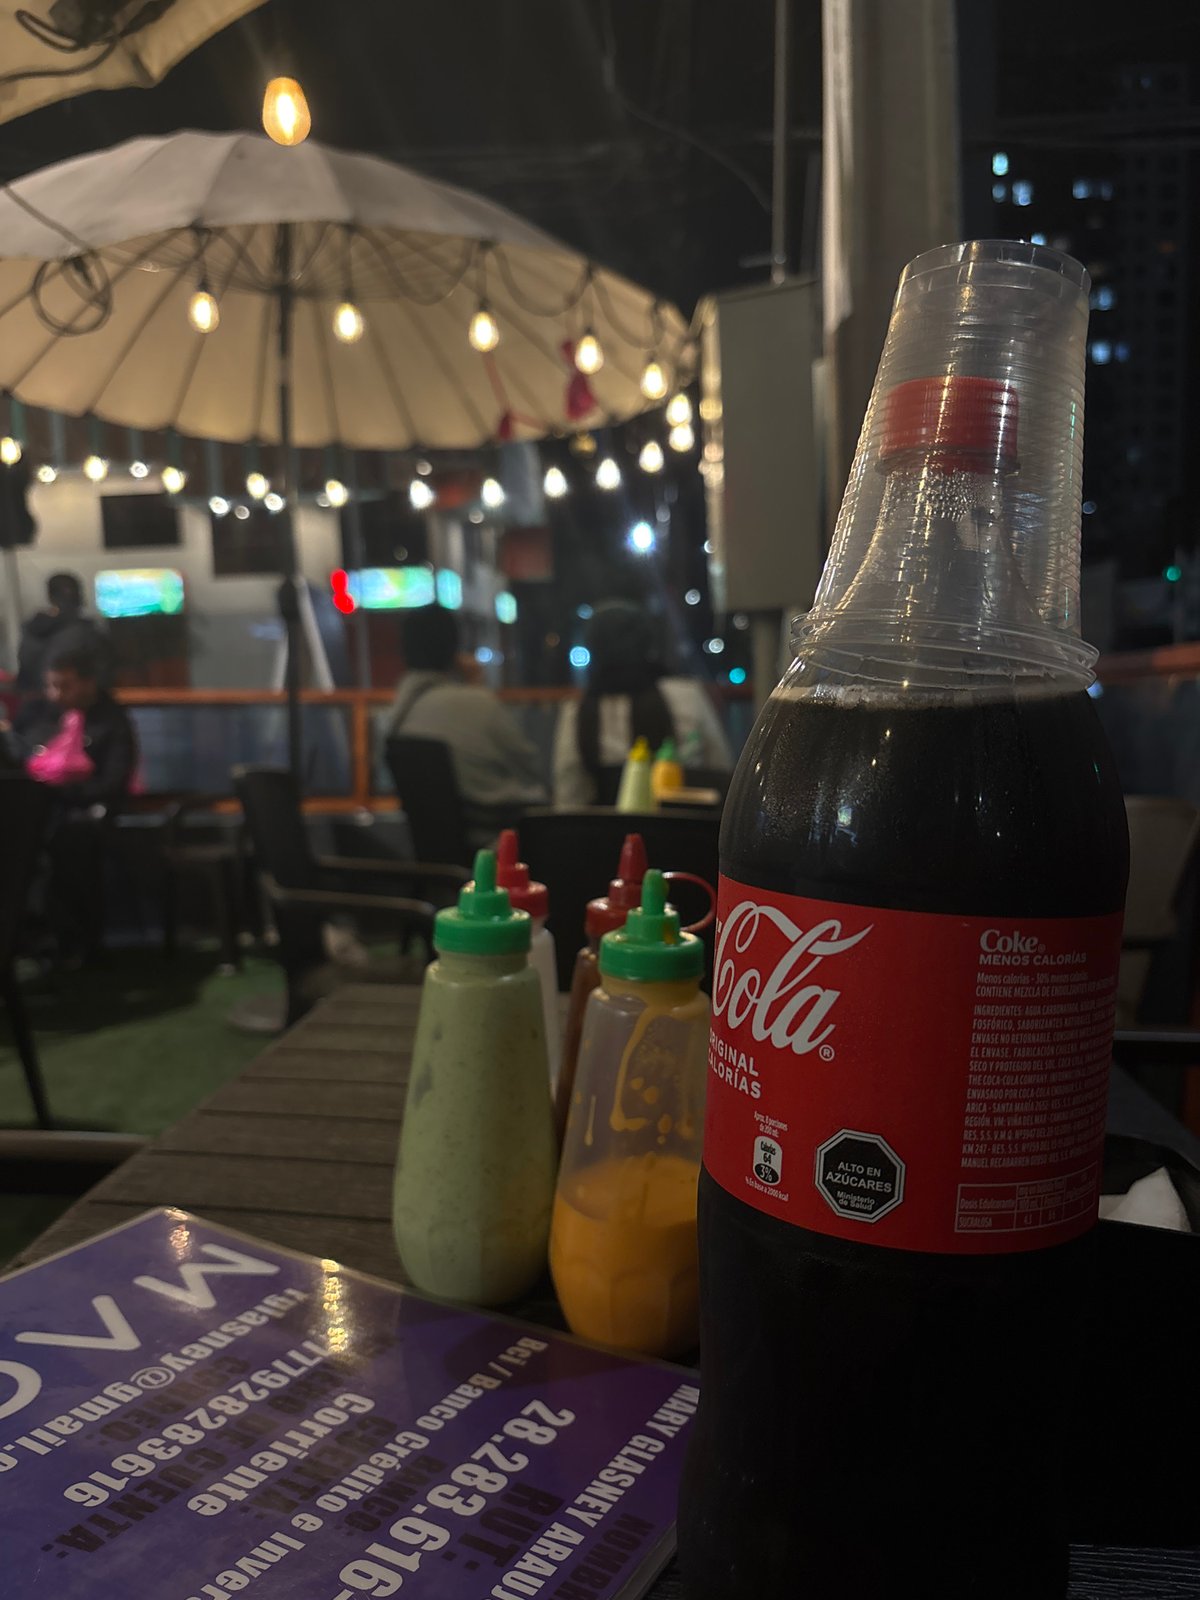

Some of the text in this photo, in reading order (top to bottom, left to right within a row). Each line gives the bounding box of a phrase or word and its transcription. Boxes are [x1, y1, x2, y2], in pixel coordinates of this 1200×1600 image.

[980, 929, 1039, 953] Coke
[979, 949, 1087, 966] MENOS CALORÍAS
[713, 901, 874, 1055] Cola
[977, 972, 1002, 984] Menos
[975, 985, 1012, 998] CONTIENE
[1014, 985, 1040, 998] MEZCLA
[971, 1032, 999, 1044] ENVASE
[1000, 1032, 1010, 1044] NO
[970, 1046, 979, 1058] EL
[969, 1061, 987, 1072] SECO
[988, 1061, 994, 1072] Y
[995, 1061, 1032, 1072] PROTEGIDO
[968, 1074, 982, 1086] THE
[982, 1074, 1019, 1086] COCA-COLA
[967, 1088, 1004, 1099] ENVASADO
[1005, 1088, 1018, 1099] POR
[966, 1102, 987, 1113] ARICA
[993, 1102, 1013, 1113] SANTA
[962, 1143, 974, 1154] KM
[974, 1143, 988, 1154] 247
[838, 1162, 881, 1177] ALTO EN
[961, 1157, 989, 1168] MANUEL
[760, 1165, 773, 1182] 3%
[826, 1171, 892, 1193] AZÚCARES
[837, 1190, 875, 1206] Ministerio
[497, 1336, 549, 1366] Bci
[415, 1372, 502, 1432] Banco
[645, 1383, 700, 1438] MARY
[186, 1392, 376, 1517] Corriente
[316, 1430, 431, 1513] Crédito
[564, 1434, 666, 1528] GLASNEY
[40, 1447, 228, 1560] CUENTA:
[291, 1512, 324, 1532] e
[441, 1481, 566, 1571] RUT:
